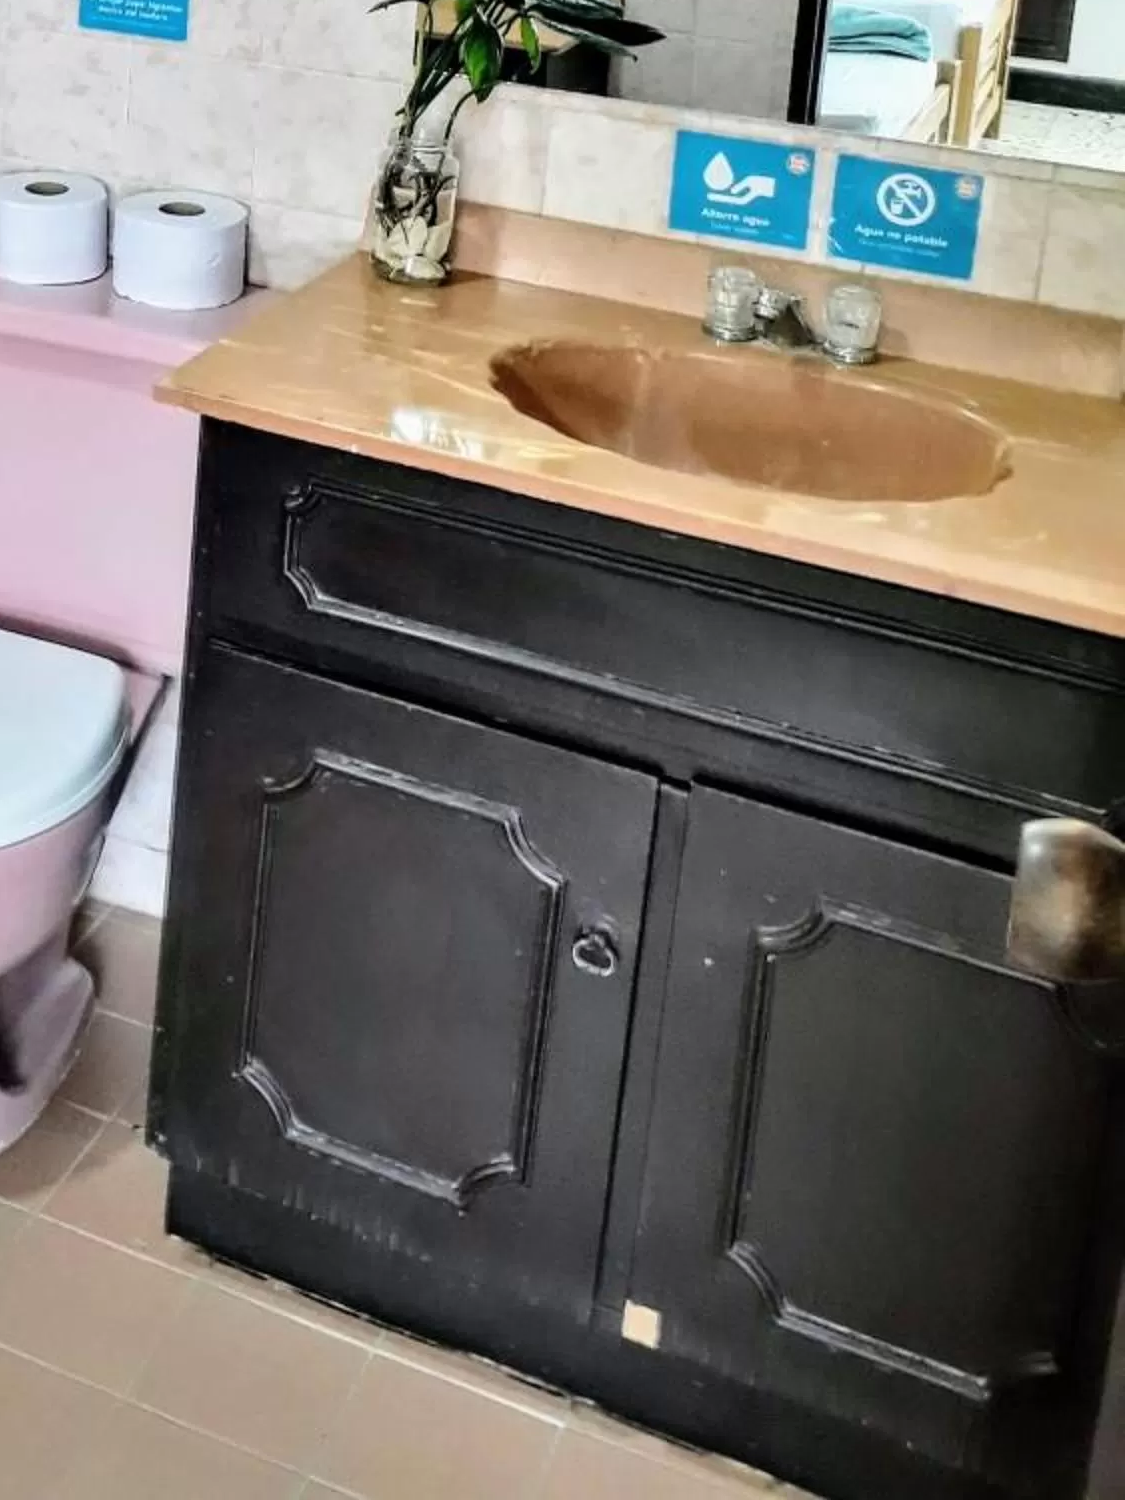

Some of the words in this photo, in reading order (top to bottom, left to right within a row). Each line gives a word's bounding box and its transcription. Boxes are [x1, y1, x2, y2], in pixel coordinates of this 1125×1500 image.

[855, 223, 884, 237] Agua
[887, 231, 902, 240] no
[904, 232, 948, 248] potable
